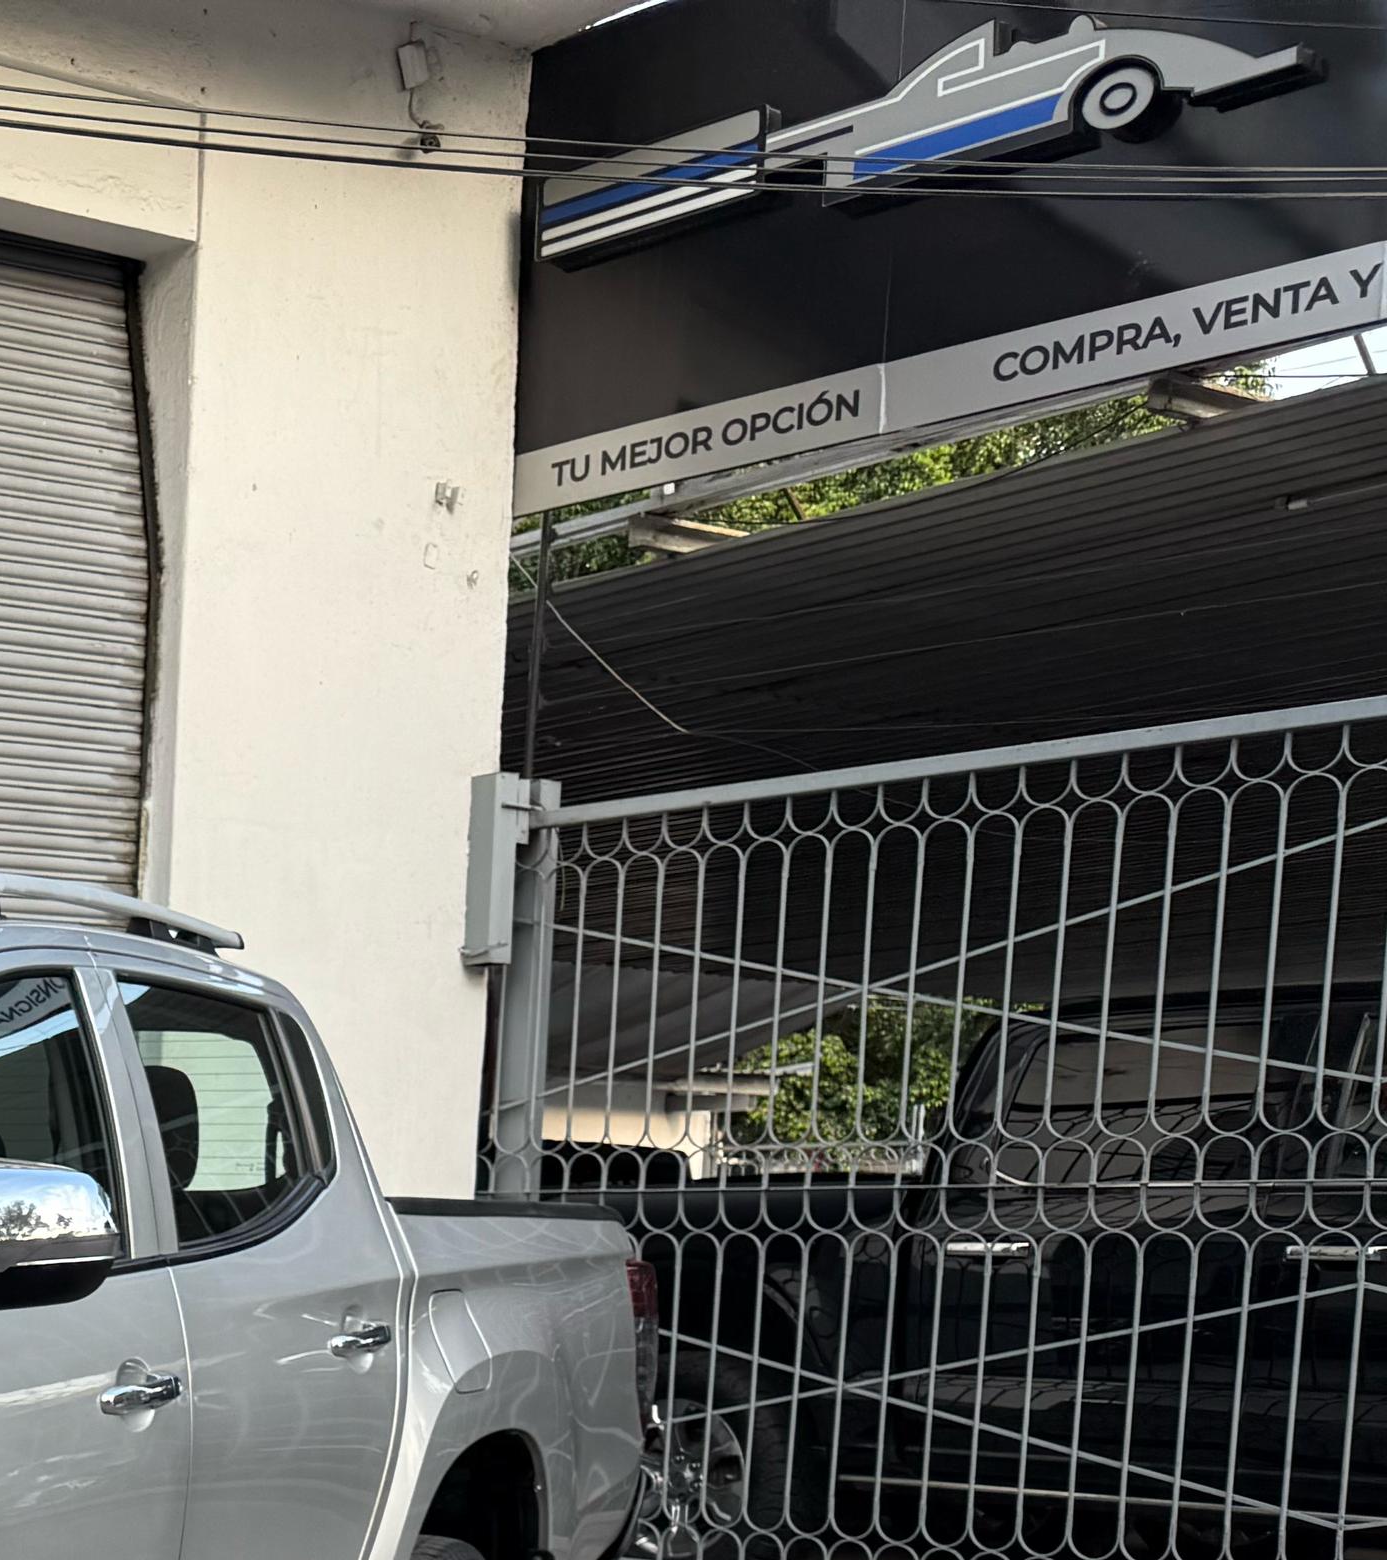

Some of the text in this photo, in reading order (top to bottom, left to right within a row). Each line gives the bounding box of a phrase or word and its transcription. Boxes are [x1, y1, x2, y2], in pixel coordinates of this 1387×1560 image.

[992, 263, 1383, 383] COMPRA, VENTA Y
[551, 389, 861, 487] TU MEJOR OPCIÓN
